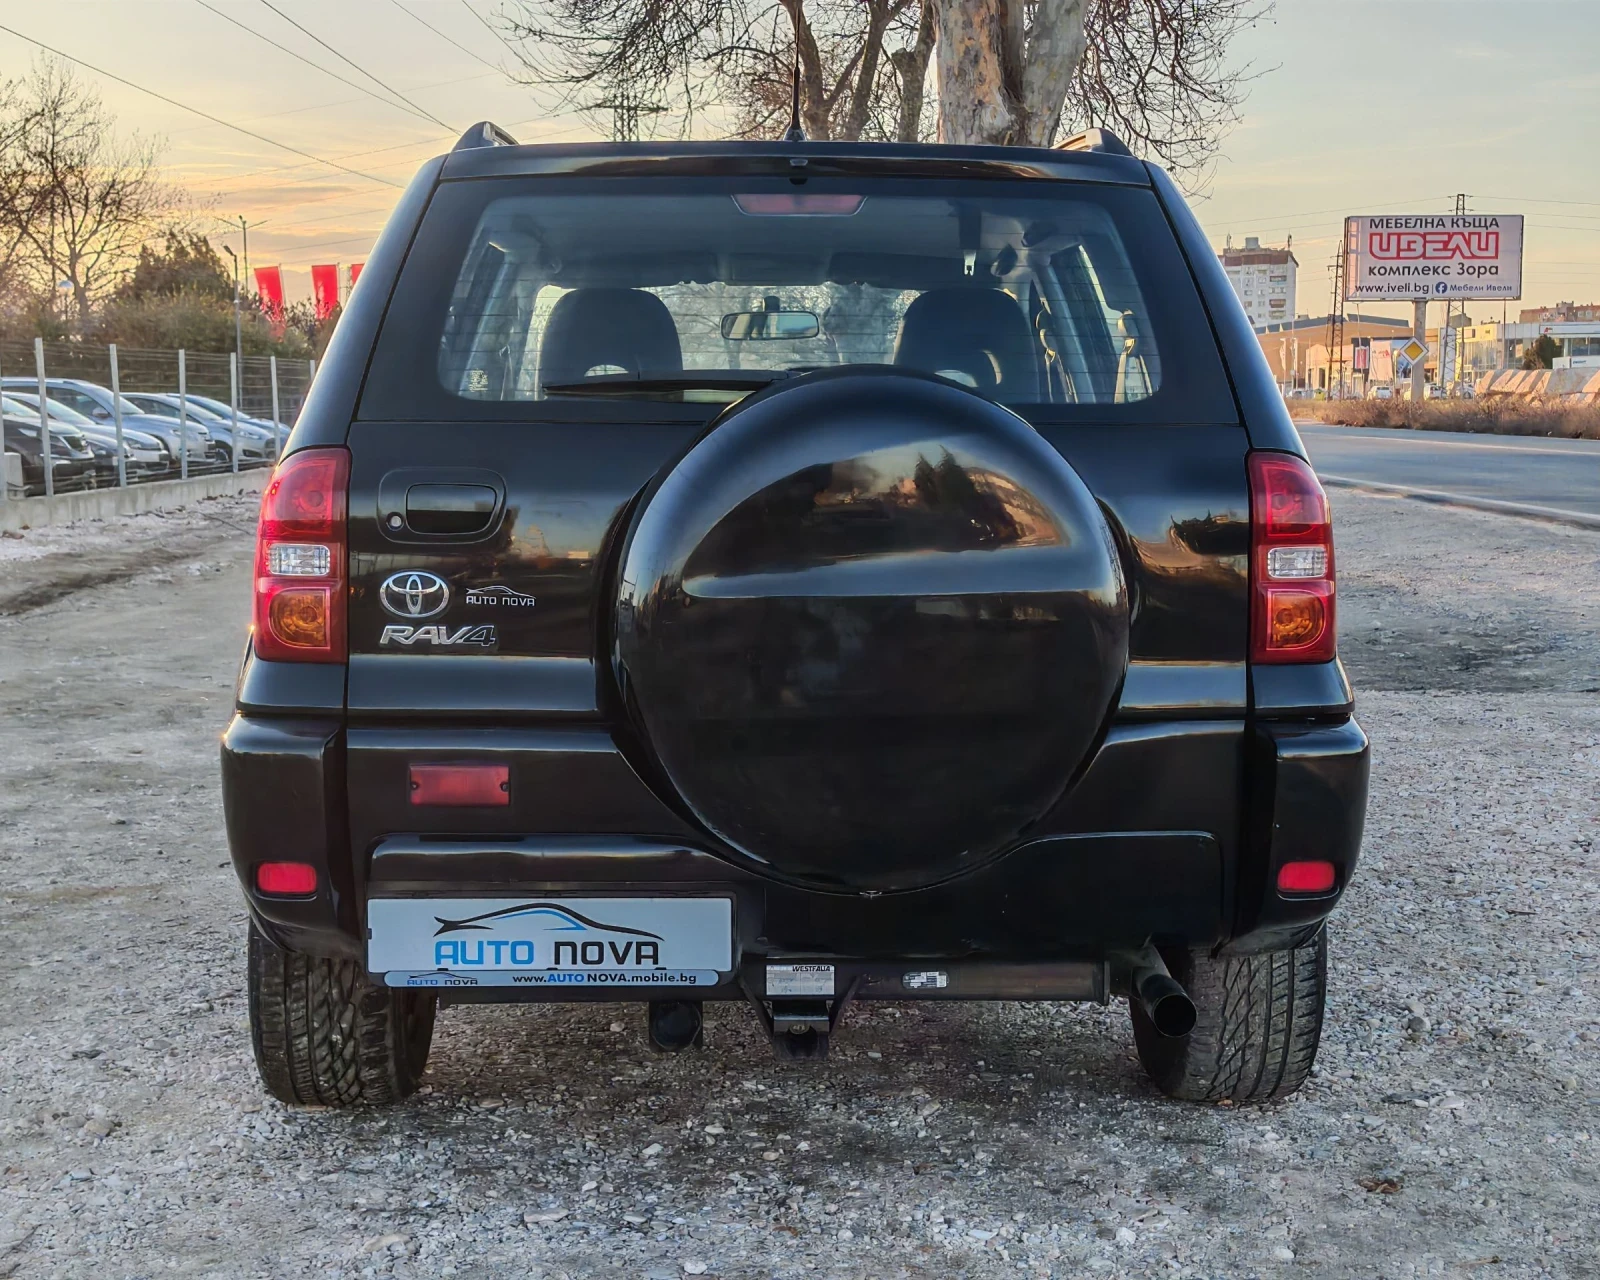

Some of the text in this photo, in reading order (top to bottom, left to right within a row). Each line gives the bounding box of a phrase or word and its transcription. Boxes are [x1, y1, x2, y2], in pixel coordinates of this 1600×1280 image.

[1369, 217, 1500, 231] МЕБЕЛНА КЪЩА
[1369, 232, 1500, 260] ИВЕЛИ
[1368, 262, 1499, 278] комплекс Зора
[1355, 282, 1430, 295] www.iveli.bg
[1449, 284, 1513, 293] Мебели Ивели
[465, 595, 536, 607] AUTO NOVA
[379, 624, 497, 647] RAV4
[434, 940, 660, 966] AUTO NOVA
